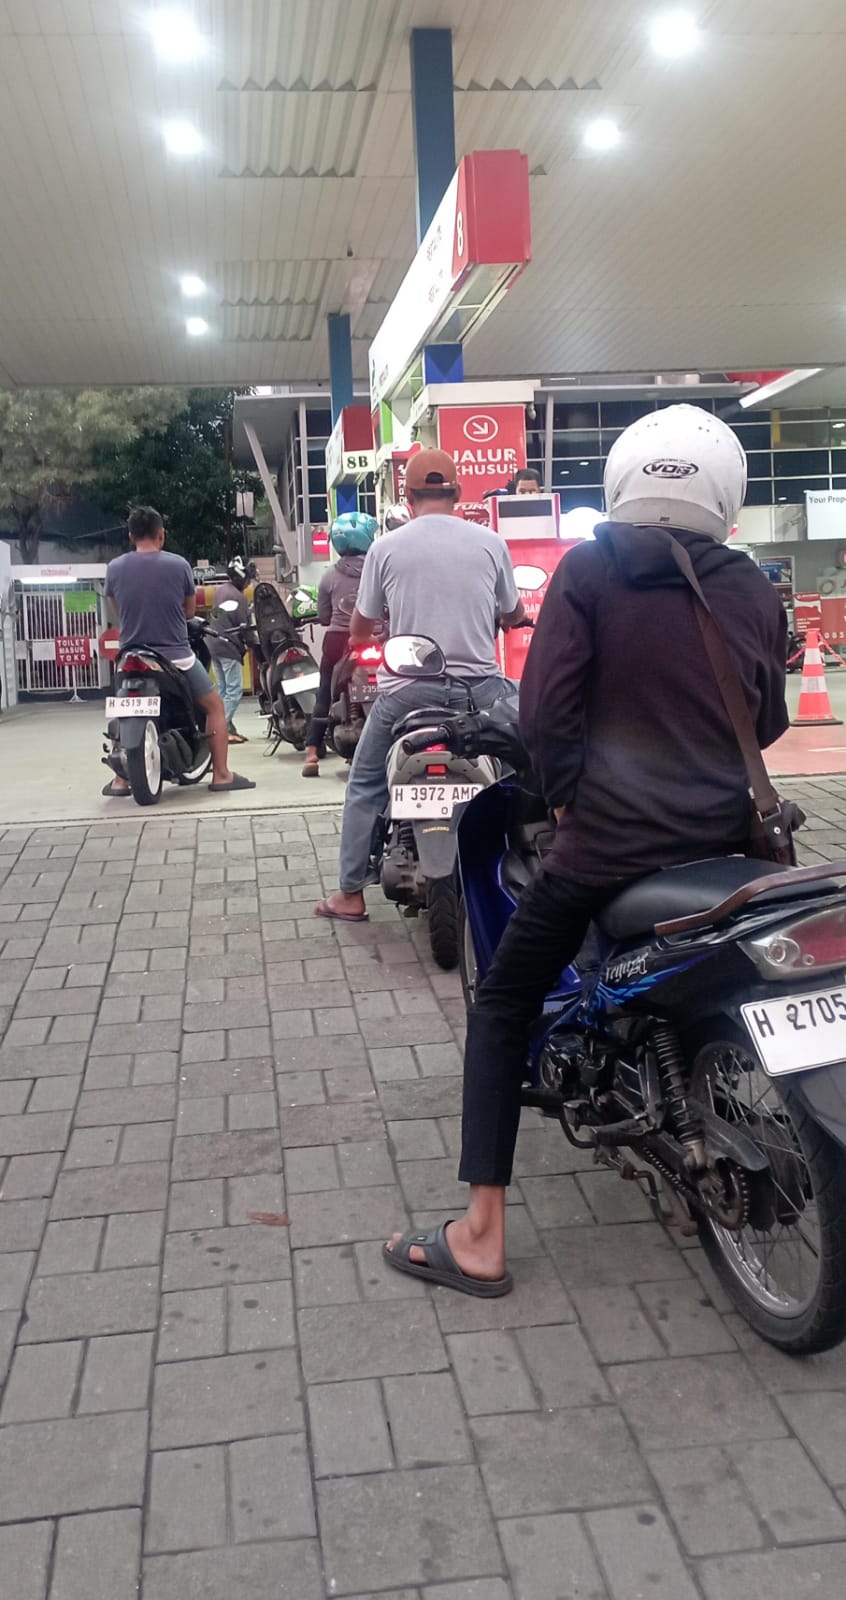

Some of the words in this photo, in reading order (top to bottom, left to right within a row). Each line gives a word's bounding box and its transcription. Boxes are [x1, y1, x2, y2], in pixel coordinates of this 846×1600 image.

[456, 210, 464, 257] 8
[453, 448, 517, 463] JALUR
[346, 455, 369, 469] 8B
[828, 495, 846, 504] Prop
[56, 639, 86, 647] TOILET
[58, 647, 86, 655] MASUK
[59, 654, 87, 662] TOKO
[109, 699, 116, 708] H
[395, 787, 404, 801] H
[410, 787, 446, 801] 3972
[752, 1008, 775, 1038] H
[786, 993, 846, 1031] 2705
